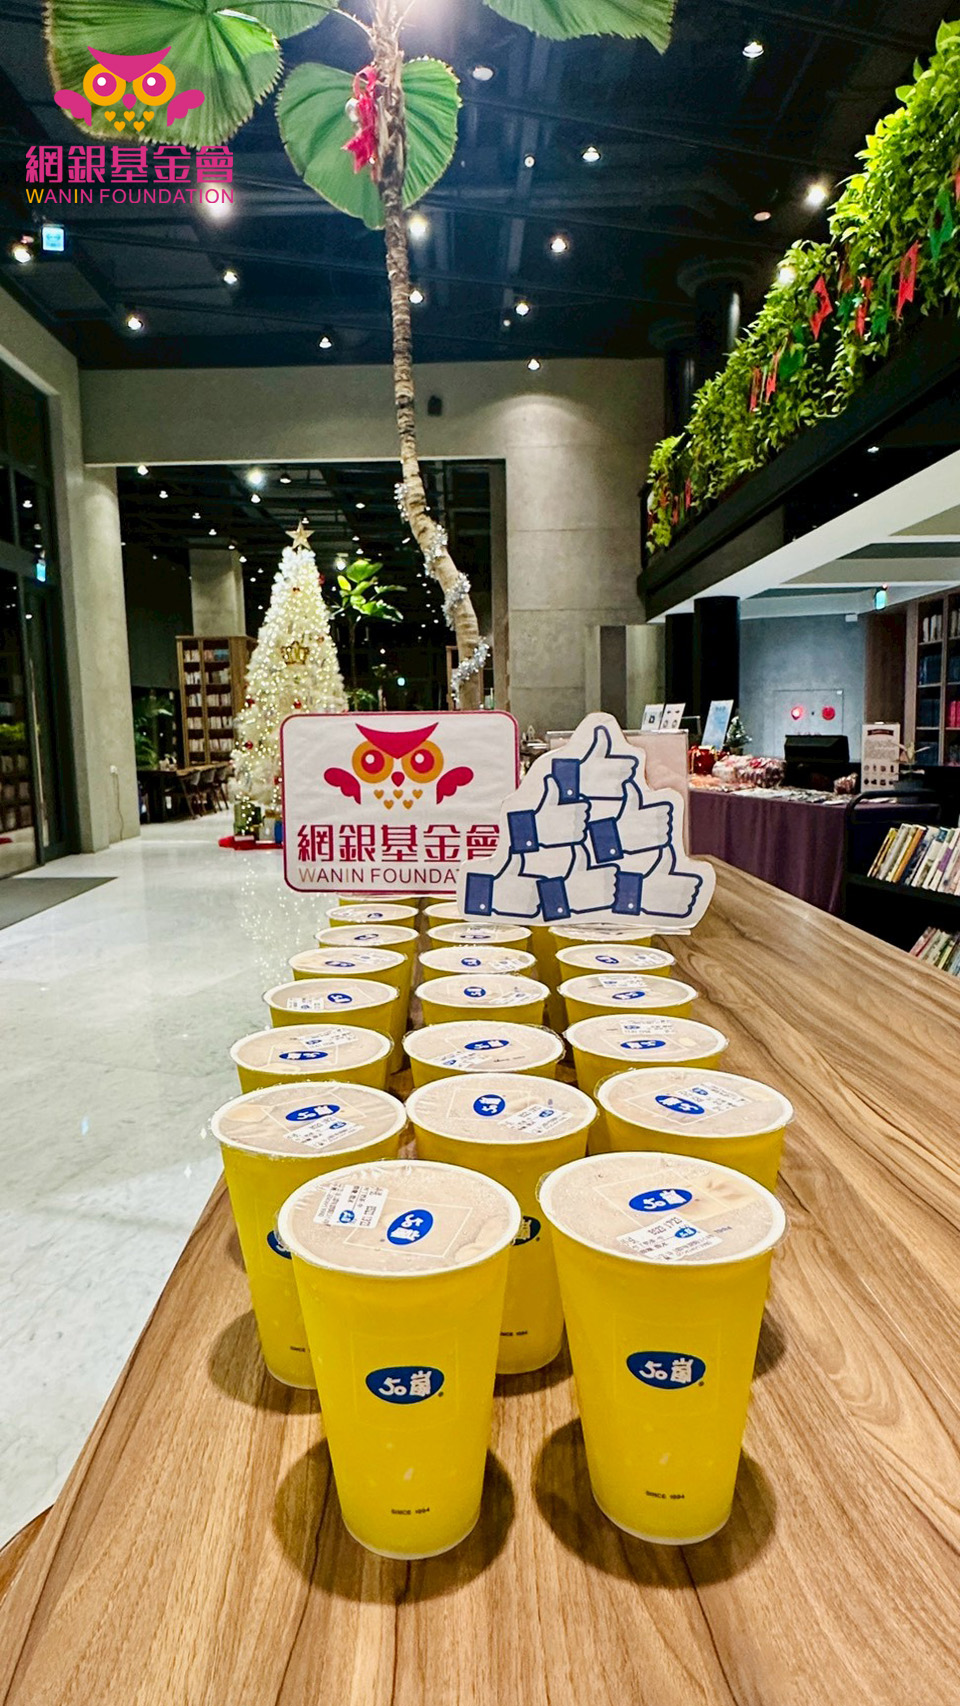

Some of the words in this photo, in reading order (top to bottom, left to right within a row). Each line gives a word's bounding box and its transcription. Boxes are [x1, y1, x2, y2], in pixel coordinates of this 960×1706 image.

[297, 824, 500, 862] 網銀基金會
[298, 868, 363, 883] WANIN
[371, 868, 460, 884] FOUNDA
[378, 1370, 432, 1397] 50嵐
[639, 1358, 694, 1384] 50嵐
